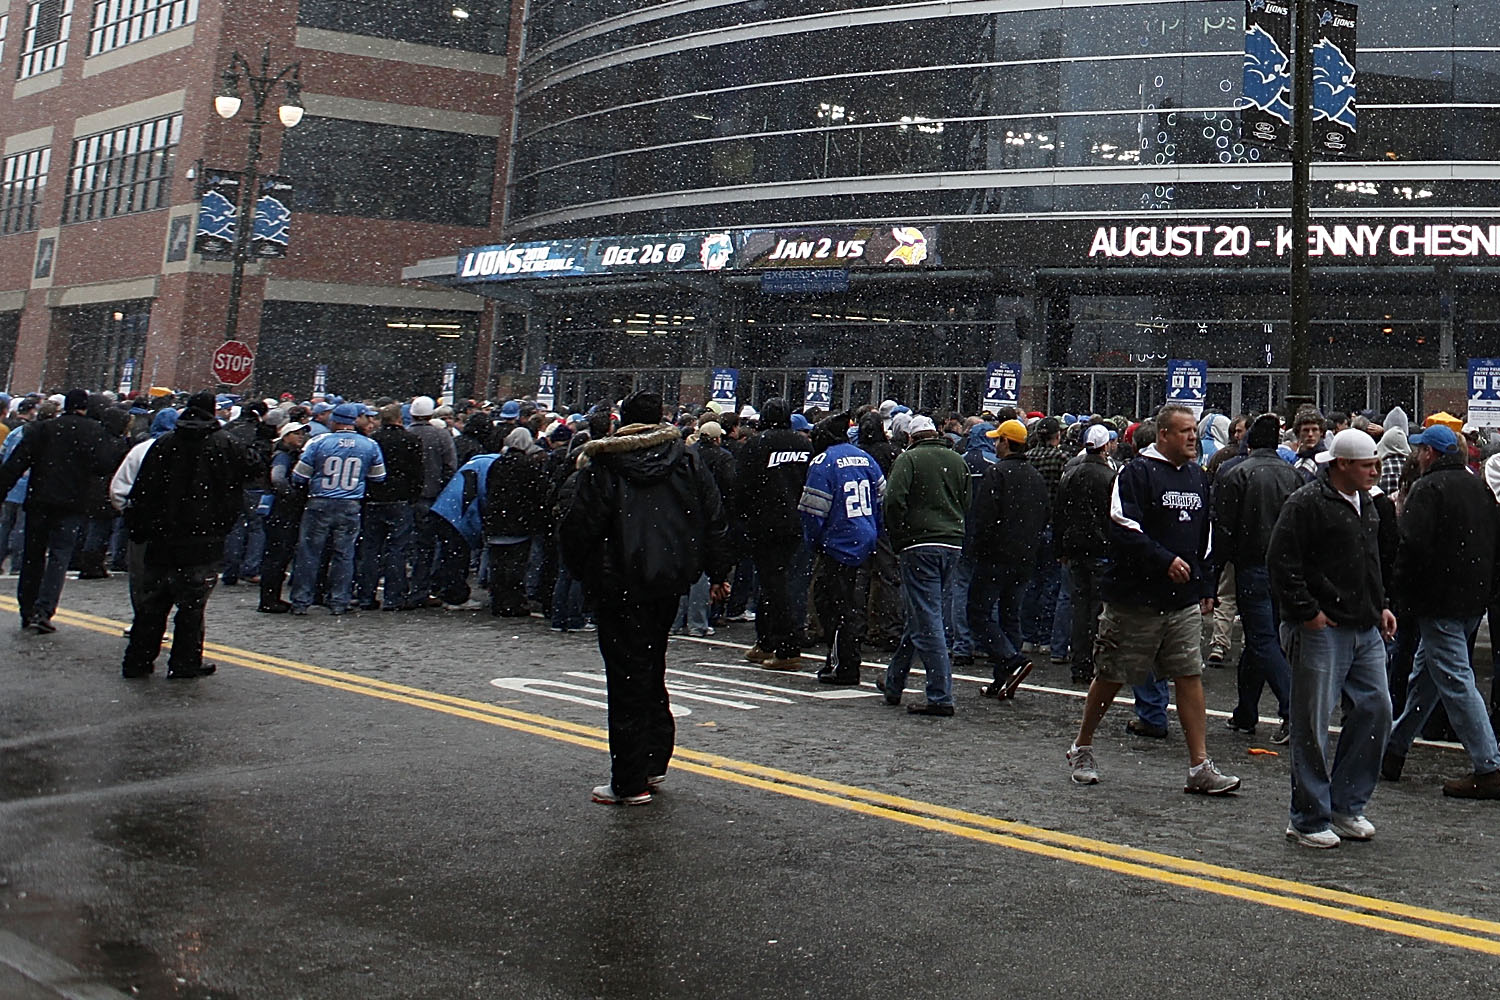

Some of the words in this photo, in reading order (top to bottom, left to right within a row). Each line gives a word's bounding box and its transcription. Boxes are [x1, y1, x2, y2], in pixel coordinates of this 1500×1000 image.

[1264, 3, 1289, 16] LIONS
[1332, 17, 1355, 28] LIONS
[769, 239, 813, 260] JAN
[814, 238, 832, 258] 2
[1089, 226, 1210, 257] AUGUST
[1213, 226, 1250, 257] 20
[601, 246, 638, 266] DEC
[639, 243, 666, 264] 26
[667, 244, 685, 263] @
[763, 269, 810, 280] EXPRESS
[215, 353, 251, 372] STOP
[338, 438, 356, 448] SUH
[767, 451, 810, 468] LIONS
[836, 456, 870, 469] SANDERS
[321, 456, 362, 491] 90
[843, 479, 872, 518] 20
